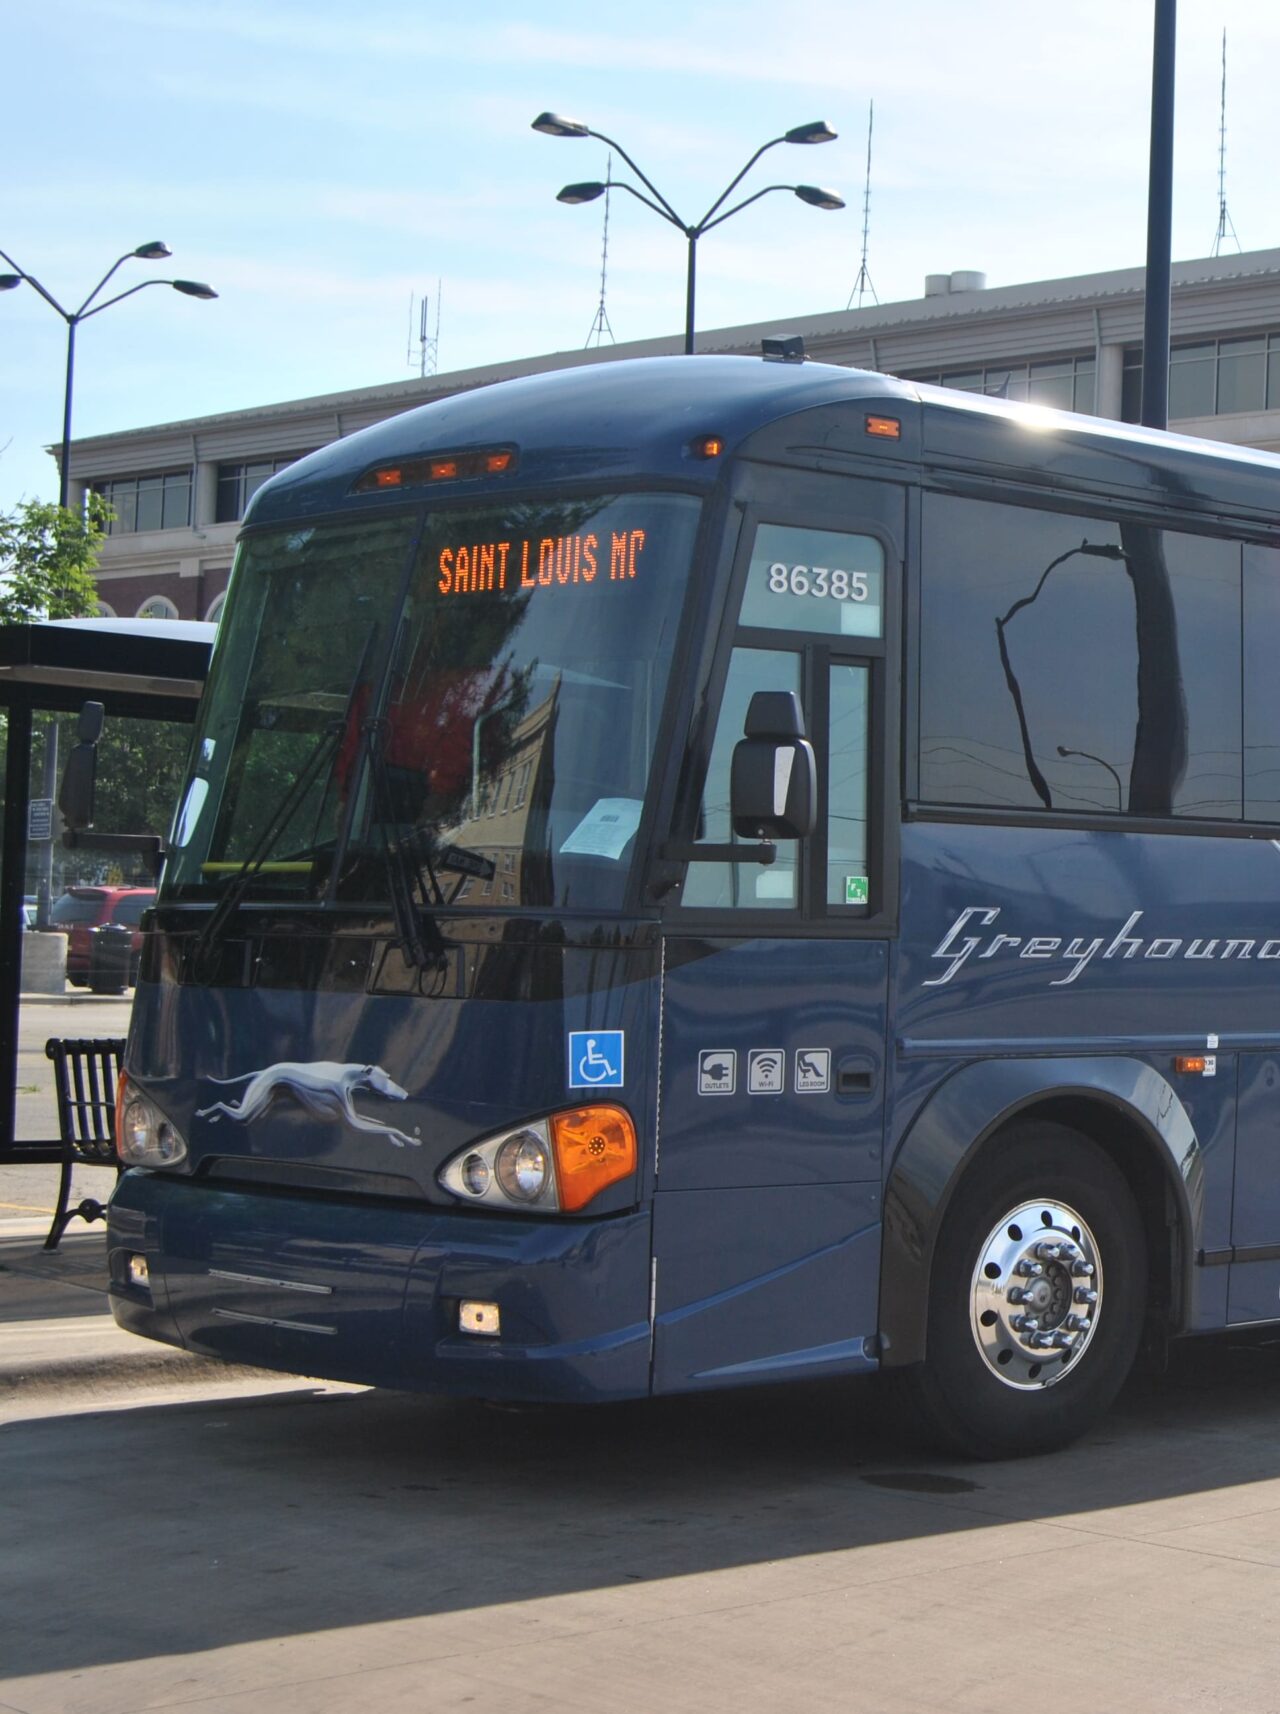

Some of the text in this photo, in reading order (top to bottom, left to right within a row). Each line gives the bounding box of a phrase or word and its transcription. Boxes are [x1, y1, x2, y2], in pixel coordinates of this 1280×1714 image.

[438, 542, 510, 594] SAINT
[521, 533, 598, 587] LOUIS
[769, 562, 868, 601] 86385
